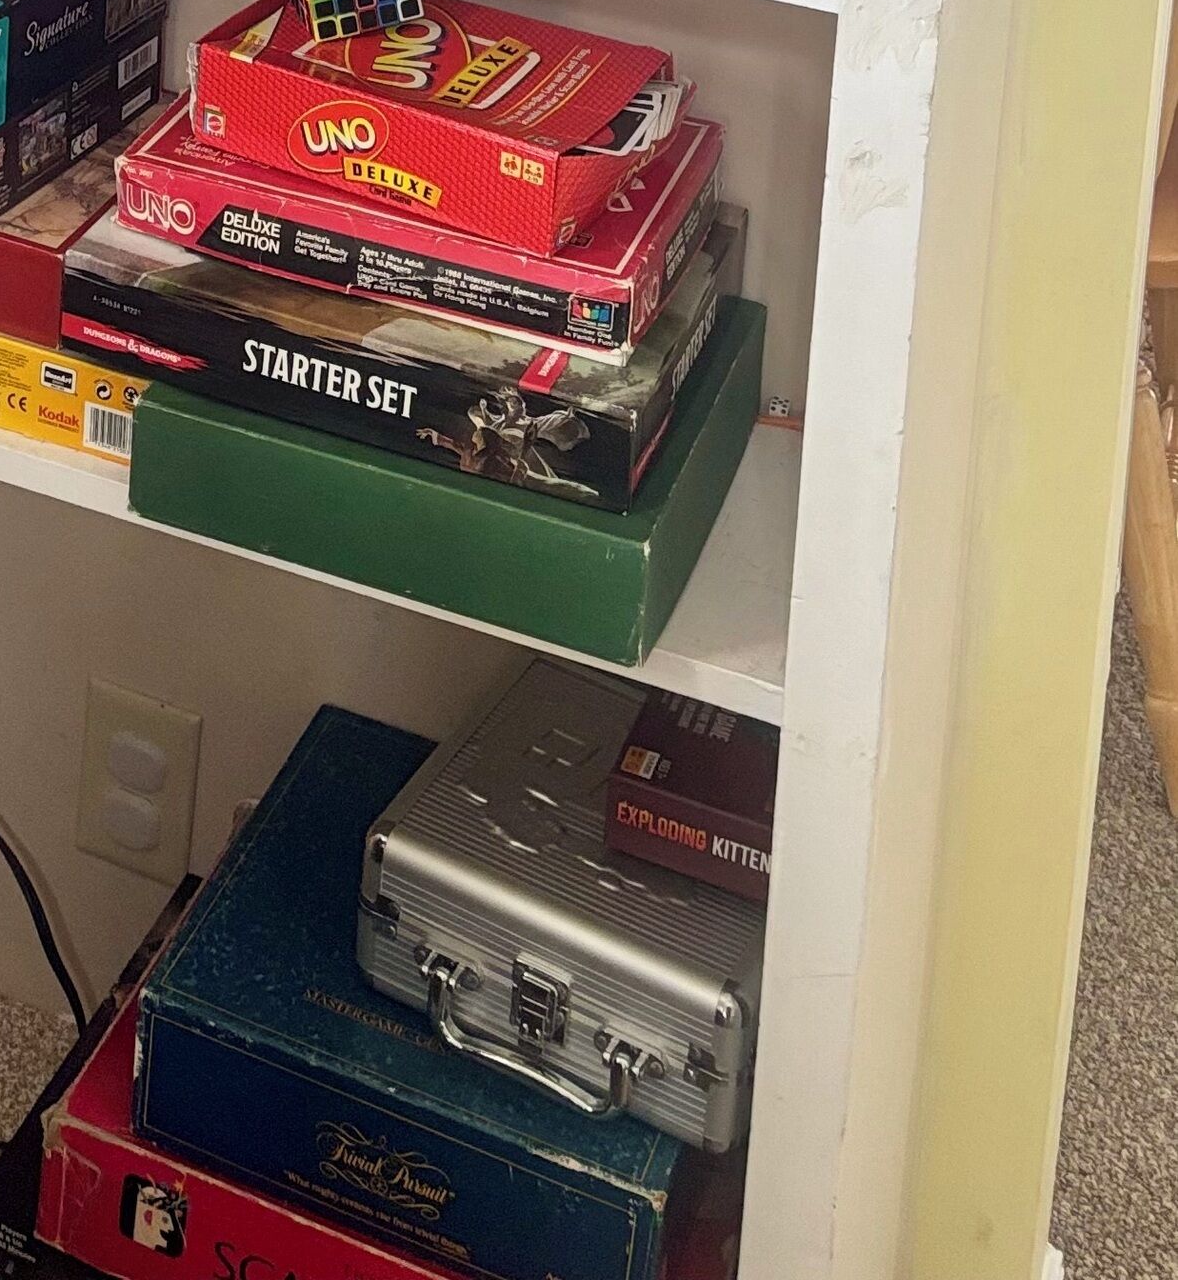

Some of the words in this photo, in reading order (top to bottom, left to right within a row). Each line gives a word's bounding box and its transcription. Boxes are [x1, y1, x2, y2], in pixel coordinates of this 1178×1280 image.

[24, 1, 90, 57] Signature
[367, 17, 444, 89] UNO
[440, 40, 521, 105] DELUXE
[302, 118, 377, 154] UNO
[352, 163, 434, 202] DELUXE
[125, 180, 197, 236] UNO
[222, 209, 282, 238] DELUXE
[221, 226, 281, 255] EDITION
[294, 237, 324, 252] Favorite
[324, 244, 349, 260] Family
[294, 245, 308, 255] Get
[295, 229, 331, 244] America's
[360, 246, 379, 258] Ages
[83, 326, 127, 349] DUNGEONS
[127, 338, 140, 353] &
[139, 344, 179, 364] DRAGONS
[242, 339, 362, 405] STARTER
[366, 376, 419, 420] SET
[7, 392, 28, 413] CE
[37, 404, 80, 428] Kodak
[616, 800, 708, 852] EXPLODING
[711, 835, 773, 874] KITTEN
[331, 1140, 384, 1178] Trivial
[390, 1164, 450, 1205] Pursuit
